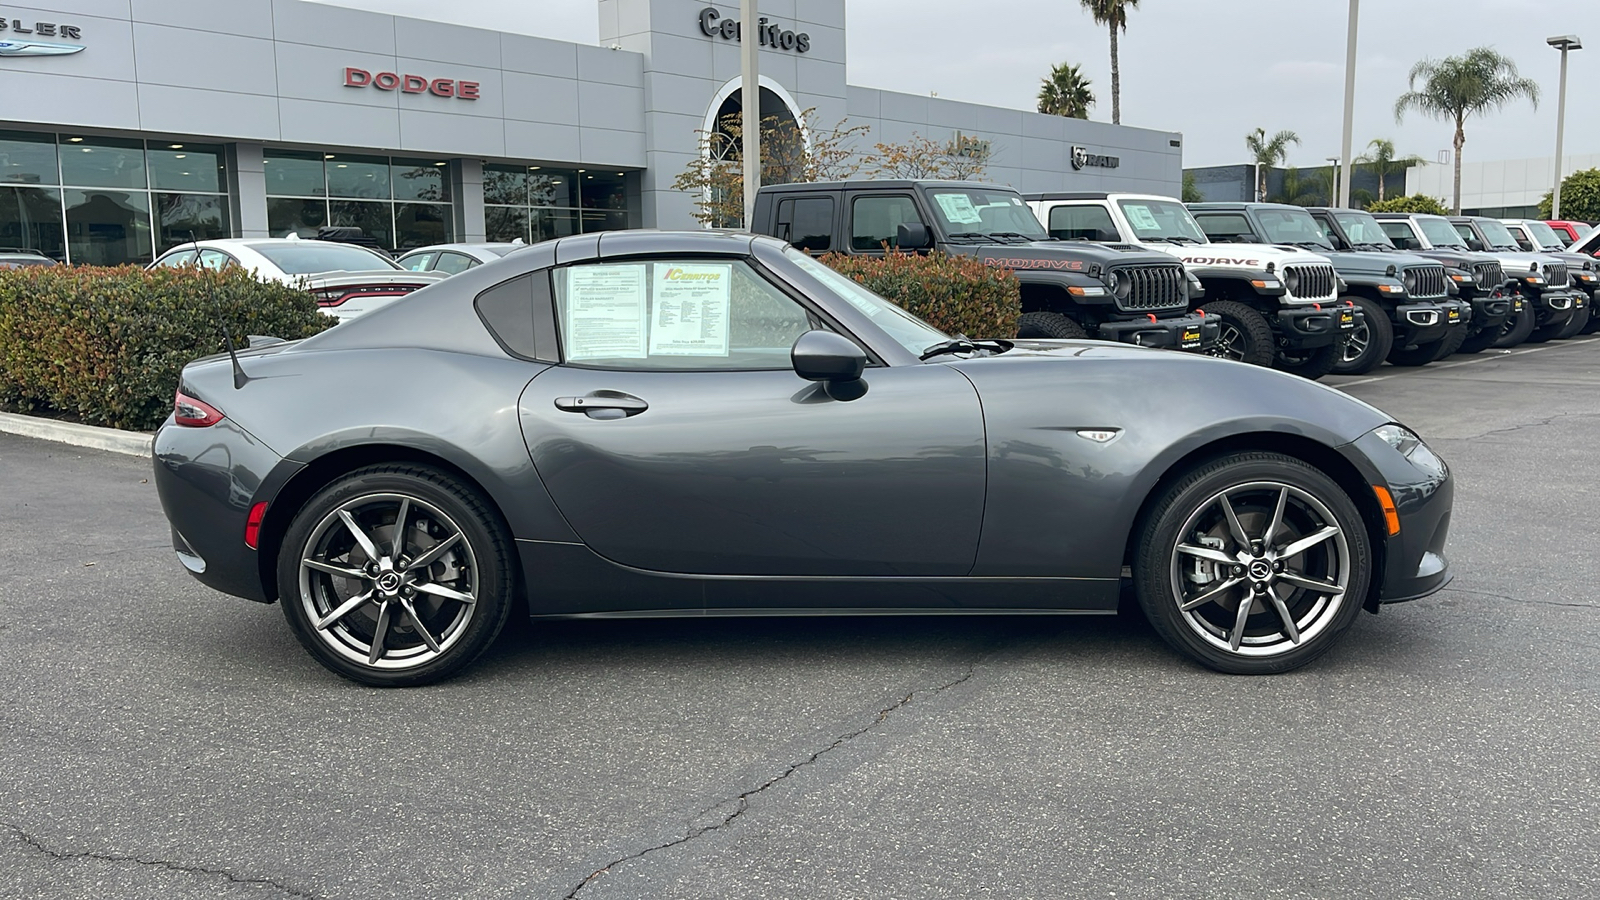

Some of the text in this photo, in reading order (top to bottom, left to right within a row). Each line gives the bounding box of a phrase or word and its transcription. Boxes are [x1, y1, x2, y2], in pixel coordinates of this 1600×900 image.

[699, 7, 810, 53] Ceitos
[343, 67, 480, 100] DODGE
[947, 130, 991, 163] Jeep
[1086, 154, 1120, 168] RAM
[985, 257, 1083, 270] MOJAVE
